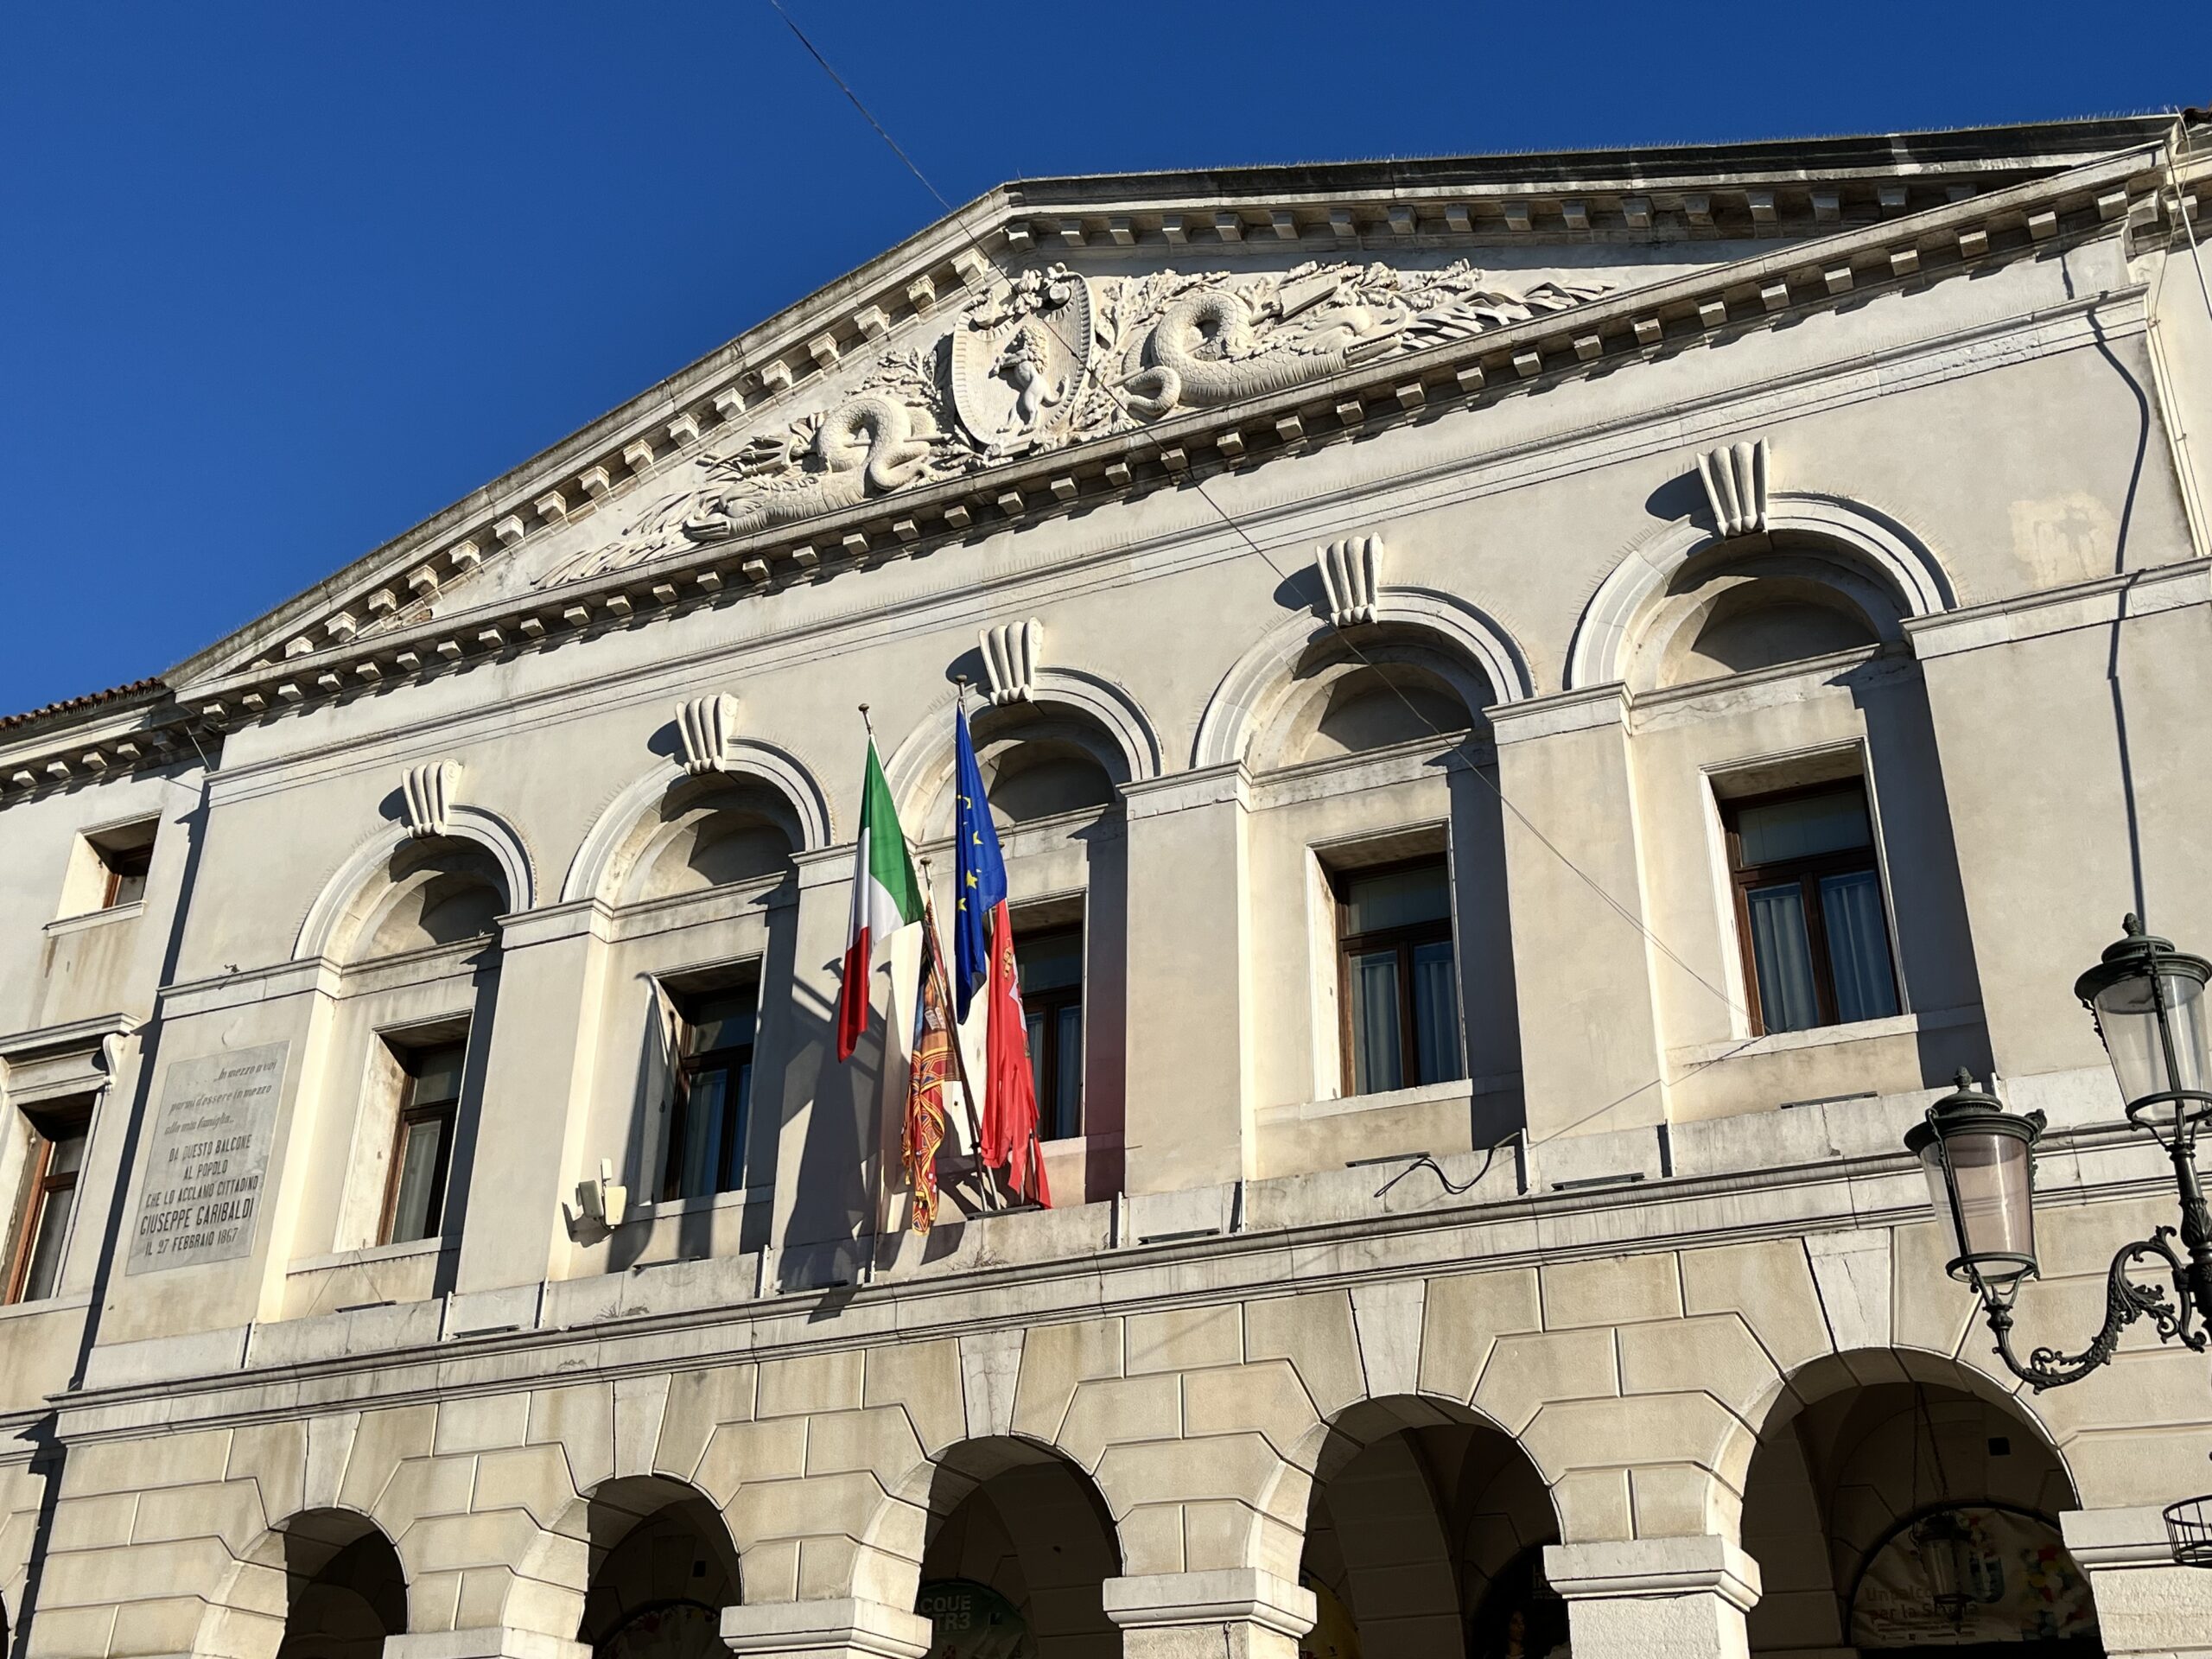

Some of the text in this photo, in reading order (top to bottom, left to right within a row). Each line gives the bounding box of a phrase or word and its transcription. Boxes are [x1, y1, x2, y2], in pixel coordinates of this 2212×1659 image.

[168, 1134, 252, 1162] DA QUESTO BALCONE
[183, 1159, 228, 1180] AL POPOLO
[145, 1192, 162, 1208] CHE
[163, 1190, 175, 1205] LO
[217, 1175, 259, 1197] CITTADINO
[140, 1197, 255, 1236] GIUSEPPE GARIBALDI
[144, 1227, 239, 1256] IL 27 FEBBRAIO 1867
[914, 1594, 971, 1613] CQUE
